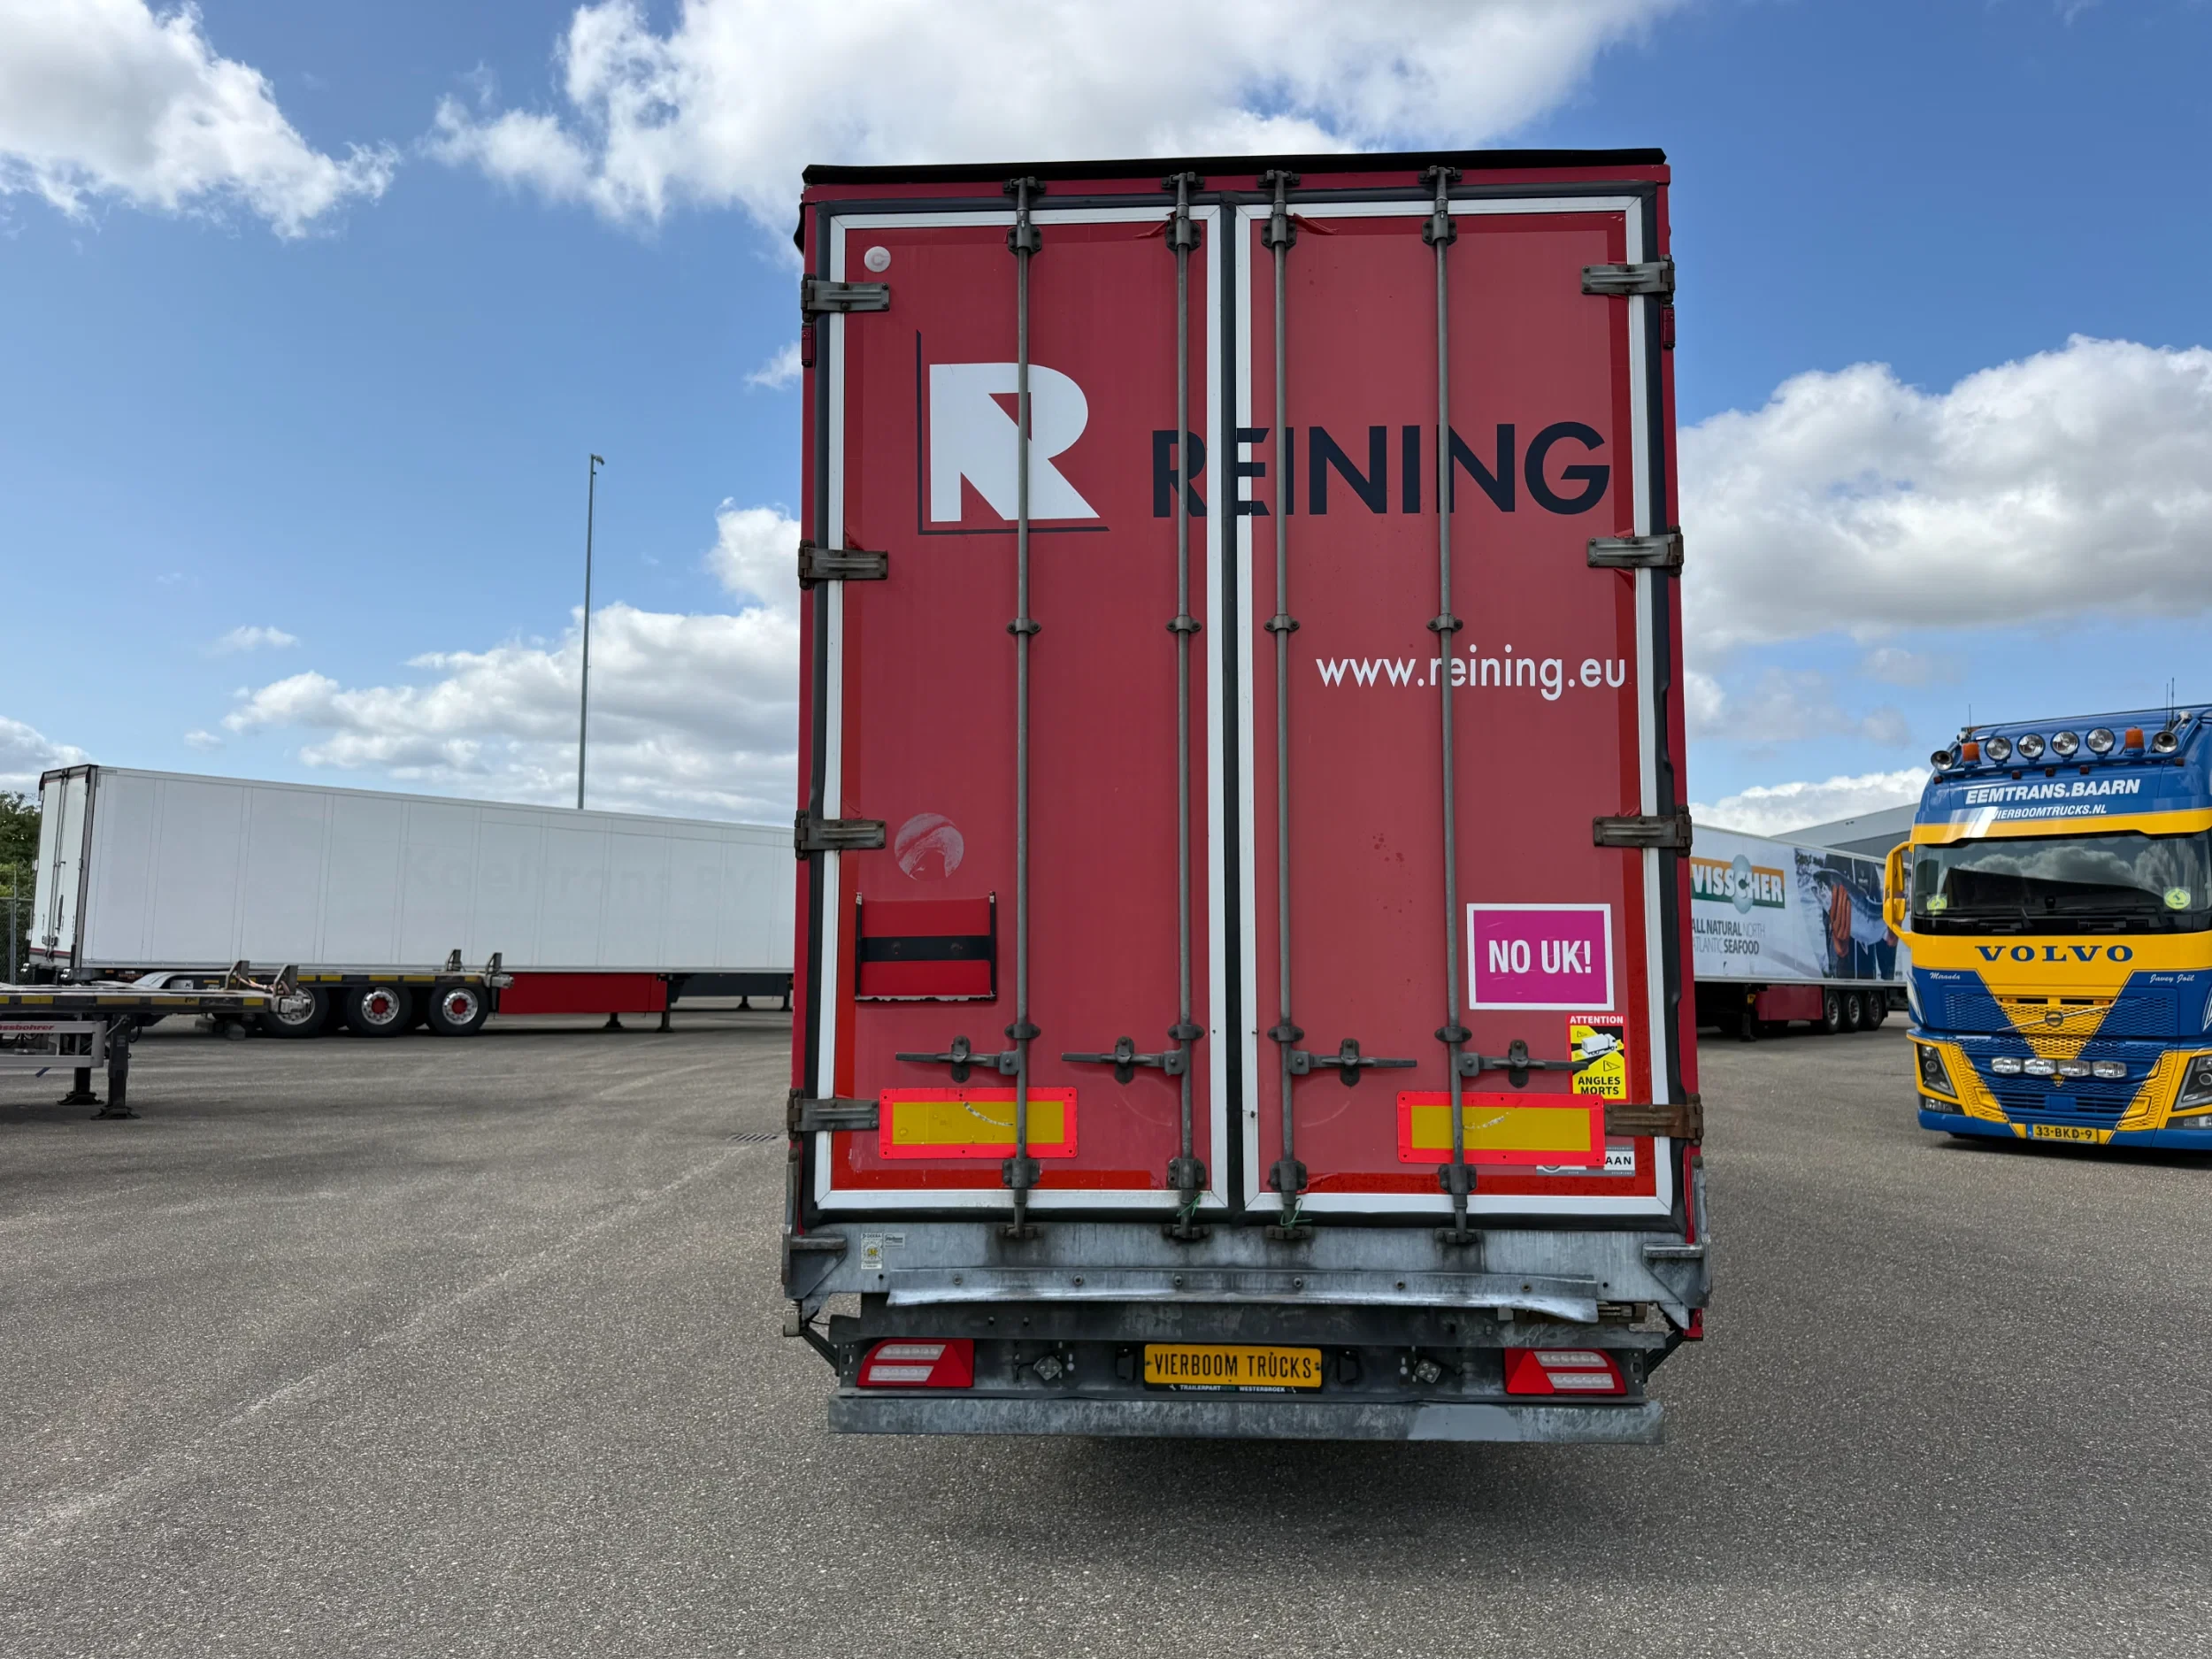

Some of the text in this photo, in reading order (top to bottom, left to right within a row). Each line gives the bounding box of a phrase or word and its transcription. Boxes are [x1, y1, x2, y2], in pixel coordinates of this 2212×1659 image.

[1152, 421, 1610, 518] REINING
[1316, 644, 1624, 701] www.reining.eu
[1965, 779, 2141, 804] EEMTRANS.BAARN
[1692, 864, 1784, 902] VISSCHER
[1706, 918, 1742, 936] NATURAL
[1743, 922, 1766, 938] NORTH
[1488, 940, 1592, 973] NO UK!
[1724, 939, 1759, 955] SEAFOOD
[1975, 945, 2133, 962] VOLVO
[1570, 1015, 1624, 1024] ATTENTION
[1578, 1076, 1621, 1086] ANGLES
[1580, 1086, 1619, 1095] MORTS
[2036, 1125, 2093, 1140] 33-BKD-9
[1154, 1353, 1312, 1379] VIERBOOM TRUCKS
